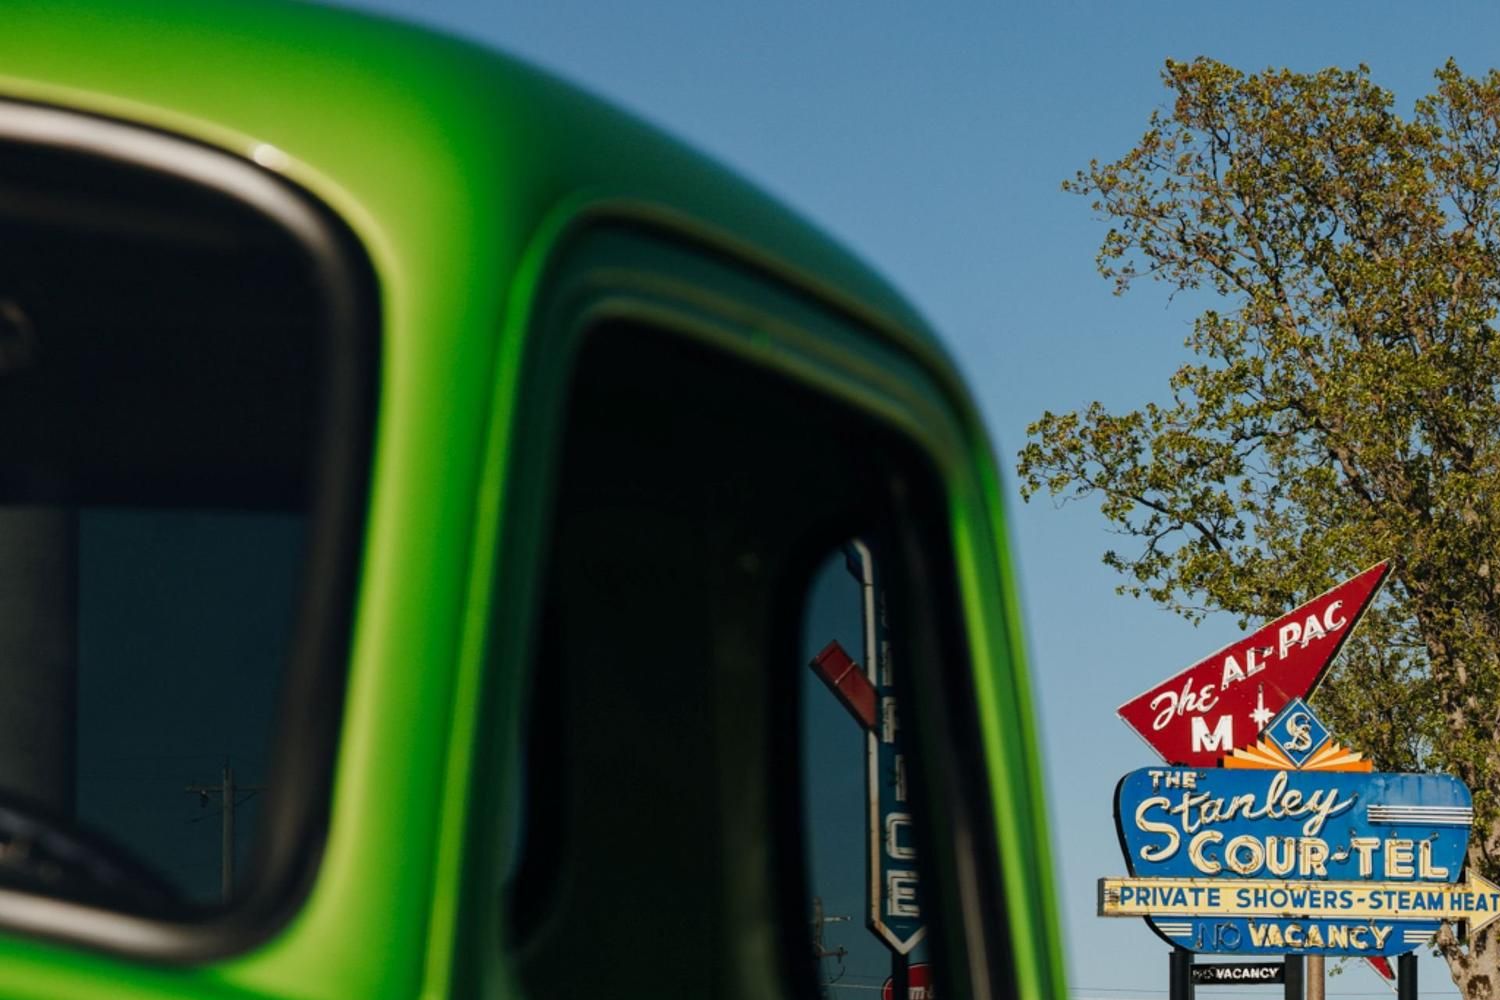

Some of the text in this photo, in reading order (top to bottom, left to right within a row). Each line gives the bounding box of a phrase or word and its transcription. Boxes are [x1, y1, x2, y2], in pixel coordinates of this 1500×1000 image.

[1151, 600, 1348, 731] The AL-PAC
[1149, 770, 1198, 788] THE
[1135, 770, 1351, 862] Stanley
[1190, 831, 1449, 879] COUR-TEL
[1119, 886, 1221, 907] PRIVATE
[1450, 892, 1500, 912] HEAT
[1248, 922, 1393, 949] VACANCY
[1216, 966, 1279, 979] VACANCY
